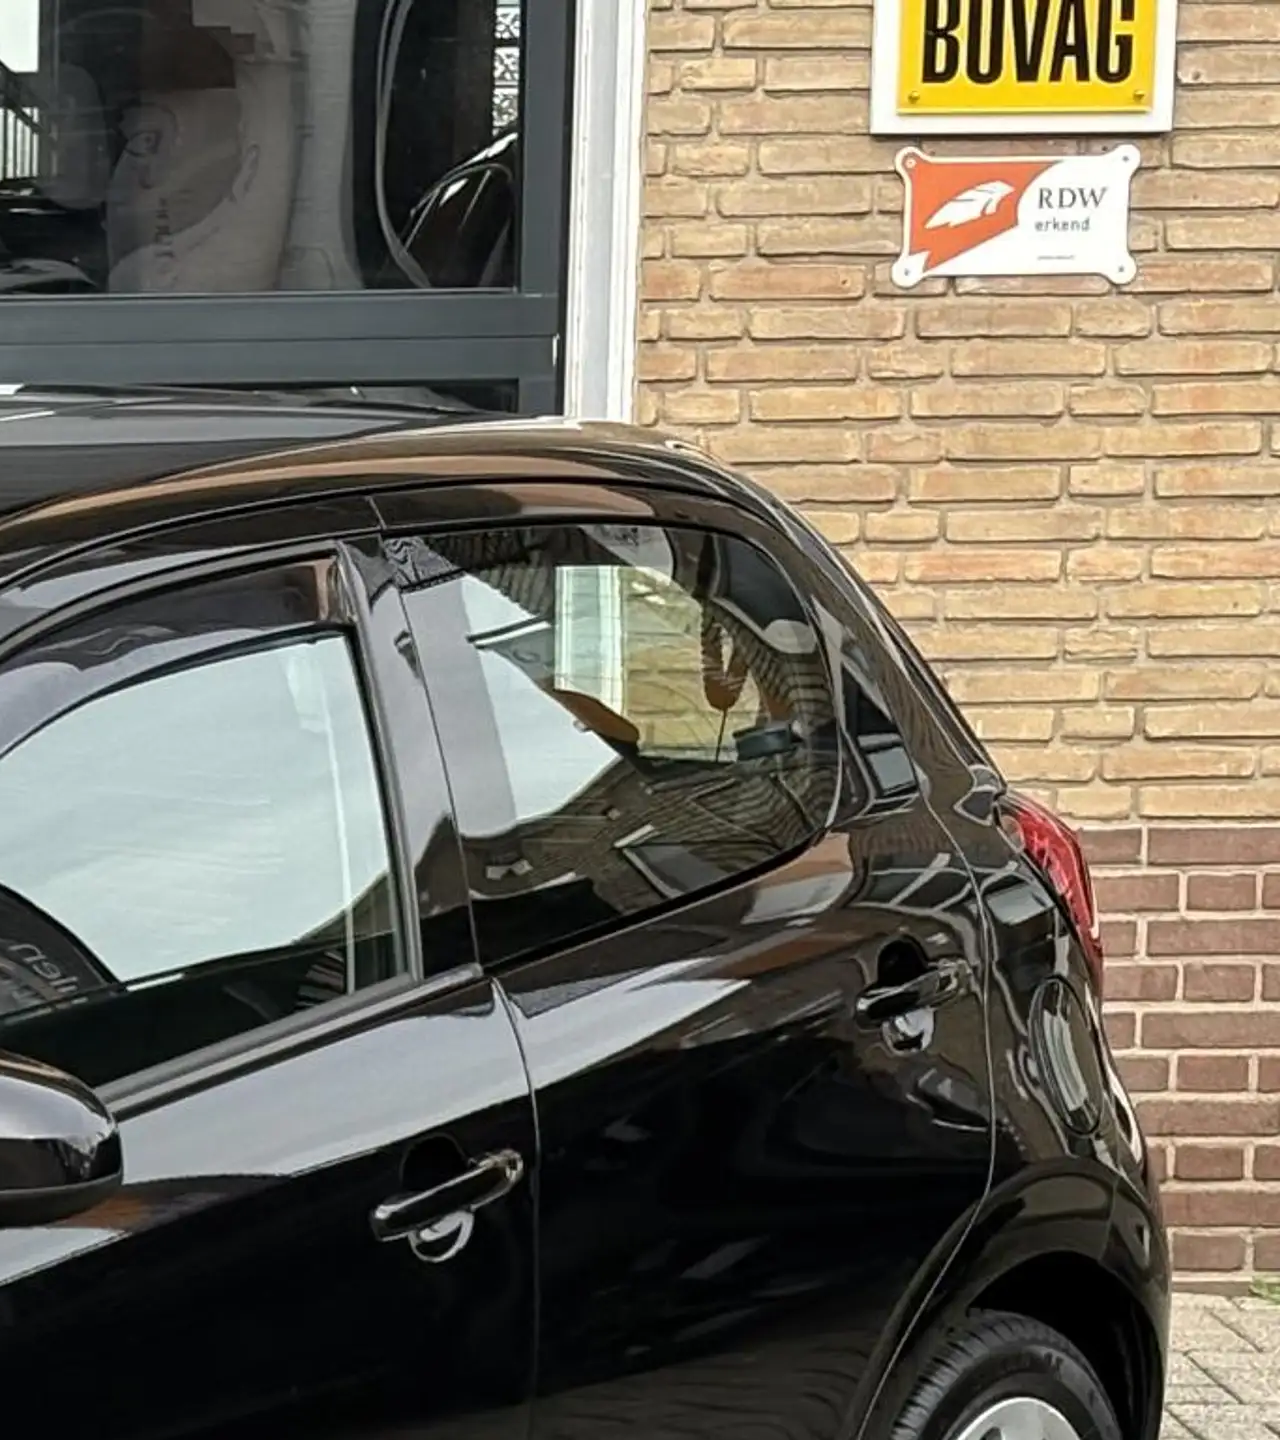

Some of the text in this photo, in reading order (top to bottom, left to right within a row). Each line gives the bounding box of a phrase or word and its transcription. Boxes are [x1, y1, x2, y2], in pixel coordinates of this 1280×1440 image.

[922, 0, 1133, 84] BOVAG
[1038, 187, 1108, 209] RDW
[1034, 216, 1090, 232] erkend
